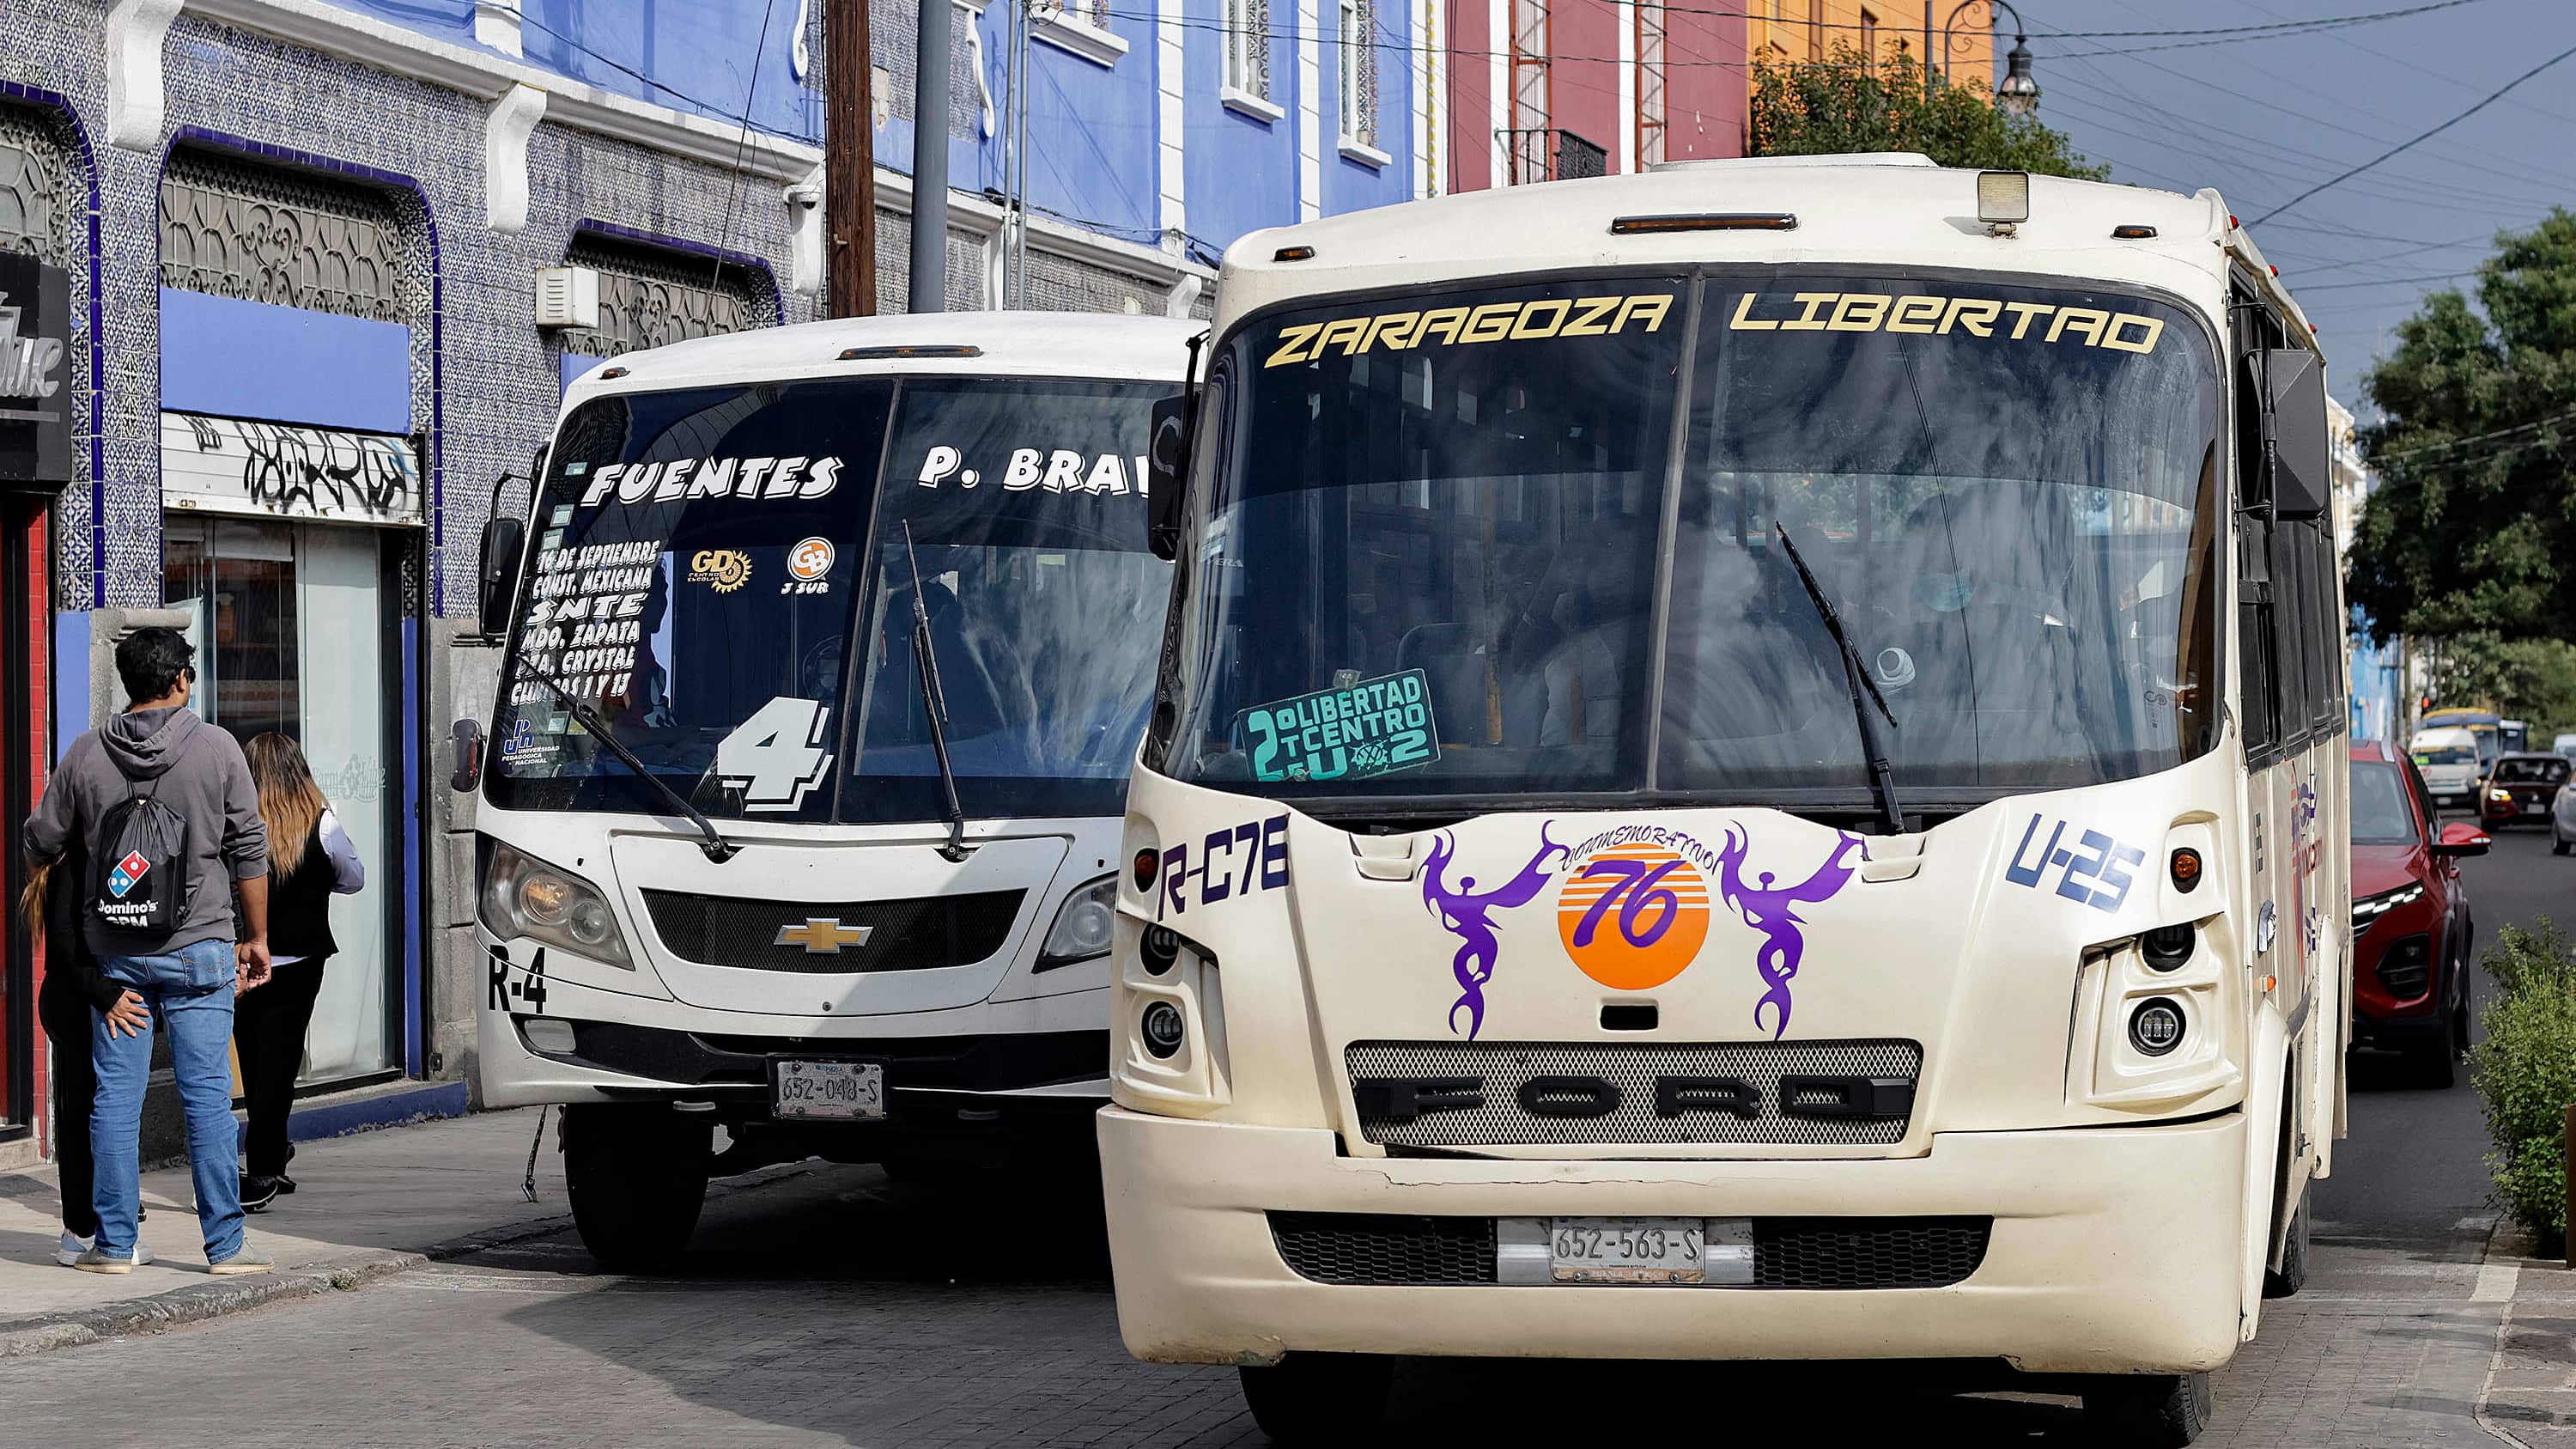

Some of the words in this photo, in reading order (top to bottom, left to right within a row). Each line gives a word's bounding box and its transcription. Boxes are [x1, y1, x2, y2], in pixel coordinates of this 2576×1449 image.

[1264, 294, 1674, 368] ZARAGOZA
[1729, 292, 2165, 355] LIBERTAD
[580, 456, 844, 507] FUENTES
[918, 446, 980, 488] P.
[537, 550, 557, 573] 16
[556, 547, 577, 570] DE
[576, 540, 659, 569] SEPTIEMBRE
[580, 568, 653, 594] MEXICANA
[795, 582, 829, 594] SUR
[526, 593, 648, 625] SNTE
[570, 621, 641, 648] ZAPATA
[562, 646, 635, 674] CRYSTAL
[582, 675, 594, 699] 1
[595, 674, 611, 697] Y
[1297, 676, 1422, 728] LIBERTAD
[1303, 703, 1425, 752] CENTRO
[514, 758, 548, 766] NACIONAL
[517, 746, 560, 754] UNIVERSIDAD
[717, 697, 835, 812] 4
[1390, 729, 1430, 764] 2
[2006, 813, 2146, 915] U-25
[1573, 860, 1686, 948] 76
[489, 945, 547, 1014] R-4
[1358, 1076, 1911, 1124] FORD
[1556, 1226, 1698, 1260] 652-563-S
